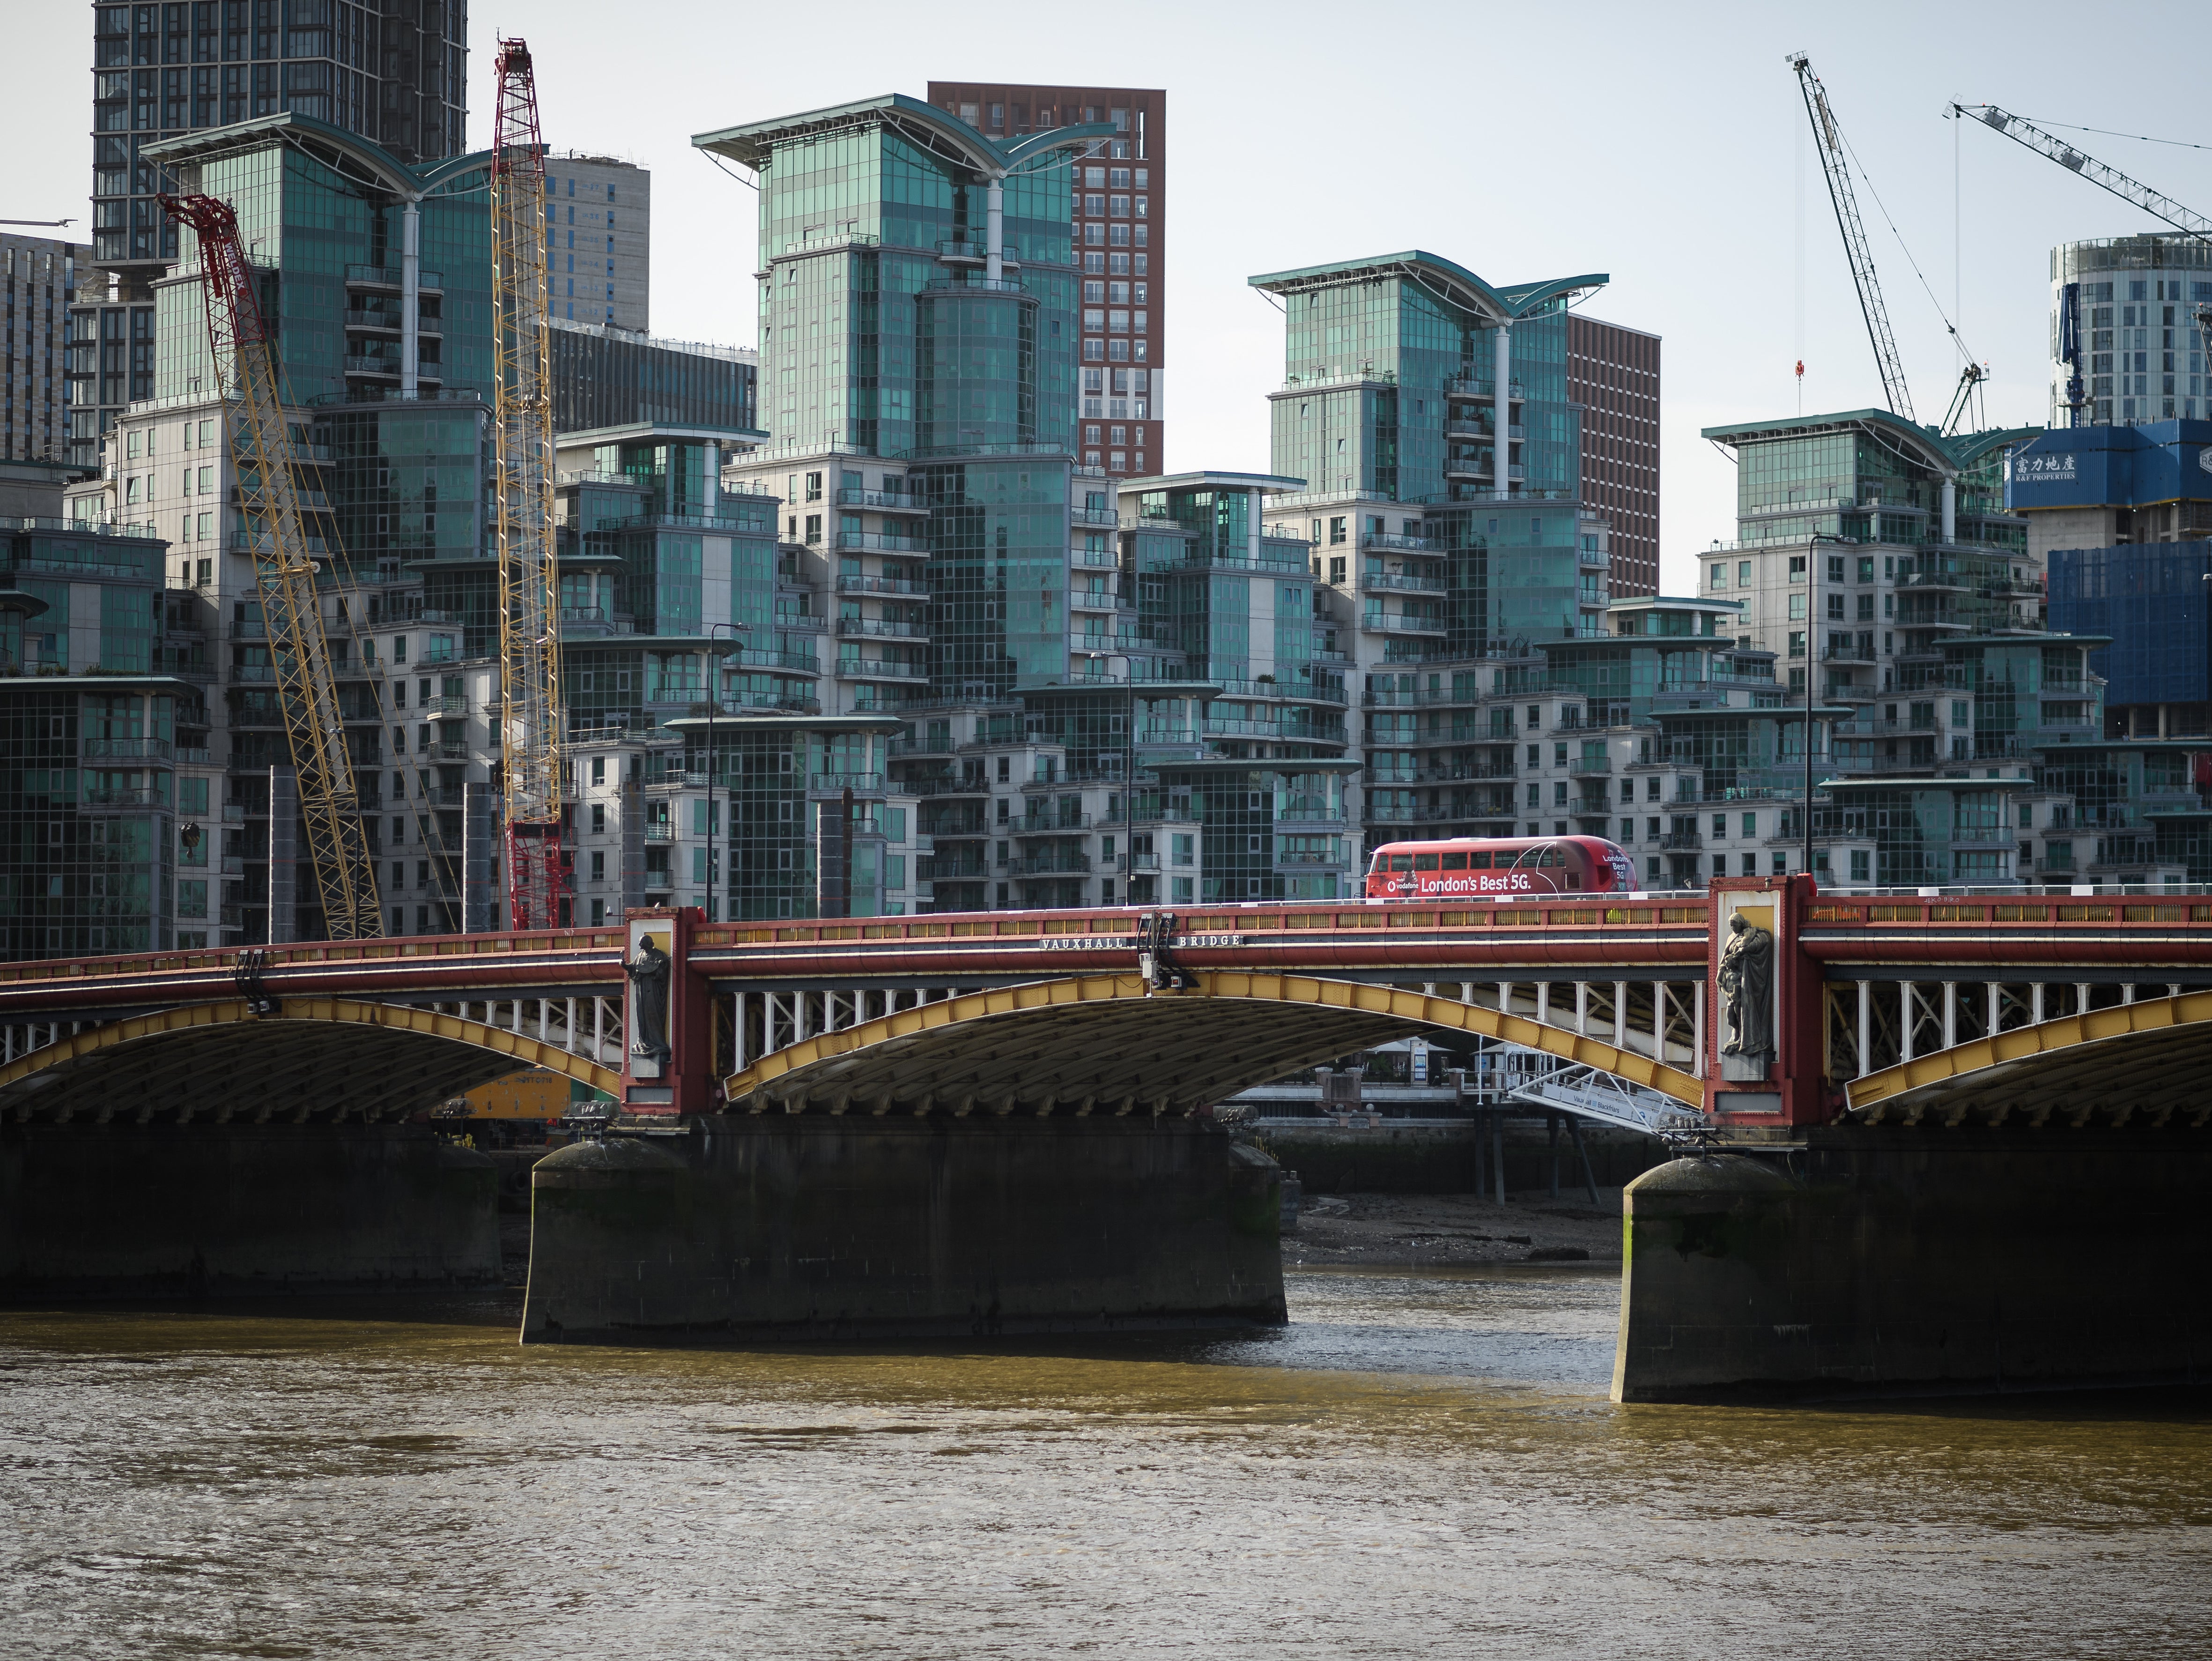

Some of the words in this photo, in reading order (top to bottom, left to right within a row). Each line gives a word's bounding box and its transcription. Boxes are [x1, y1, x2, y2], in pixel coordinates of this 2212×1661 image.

[225, 242, 245, 289] WELDEX
[1480, 875, 1508, 890] Best
[1510, 874, 1531, 890] 5G.
[1043, 938, 1122, 949] VAUXHALL
[1180, 935, 1239, 946] BRIDGE
[1574, 1095, 1591, 1105] Vauxall
[1598, 1102, 1620, 1113] Blackfriars
